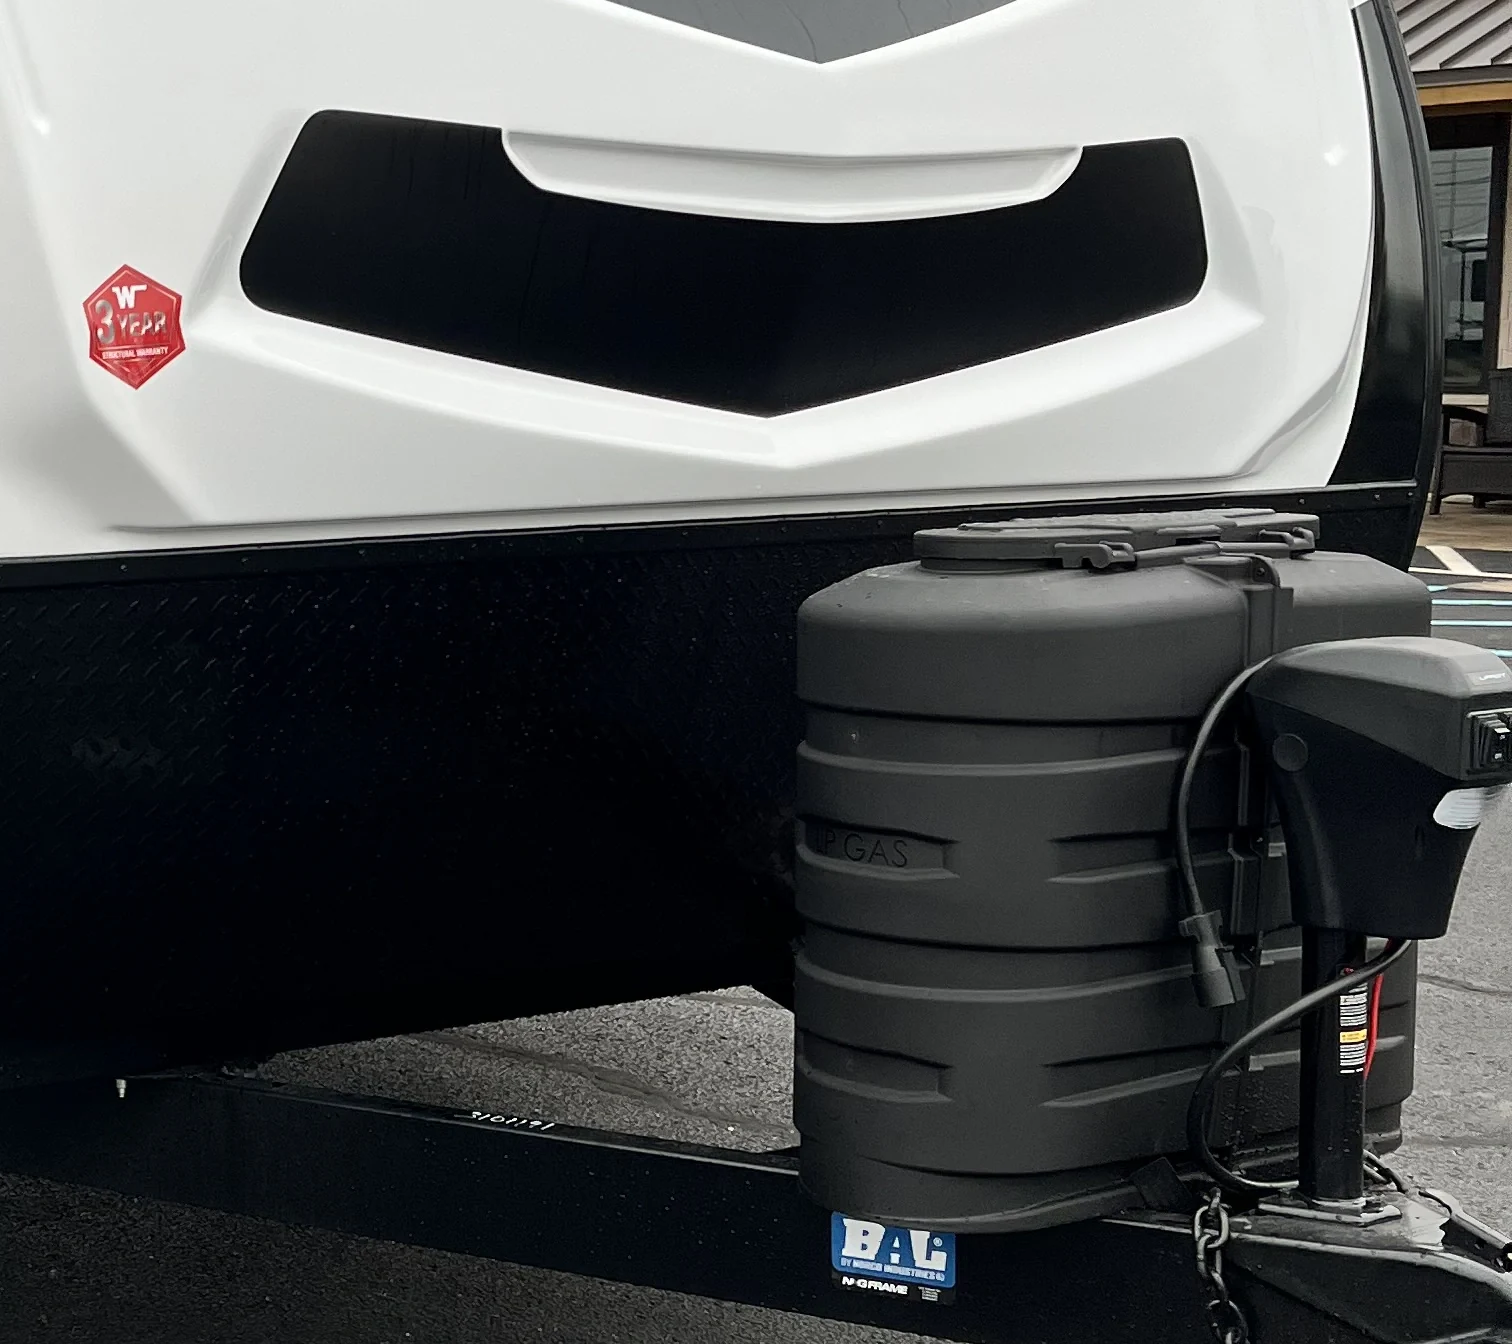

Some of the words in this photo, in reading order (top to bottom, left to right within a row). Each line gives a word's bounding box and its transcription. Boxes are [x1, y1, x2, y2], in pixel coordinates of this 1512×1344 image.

[95, 299, 115, 344] 3
[116, 311, 167, 338] YEAR
[844, 832, 908, 868] GAS
